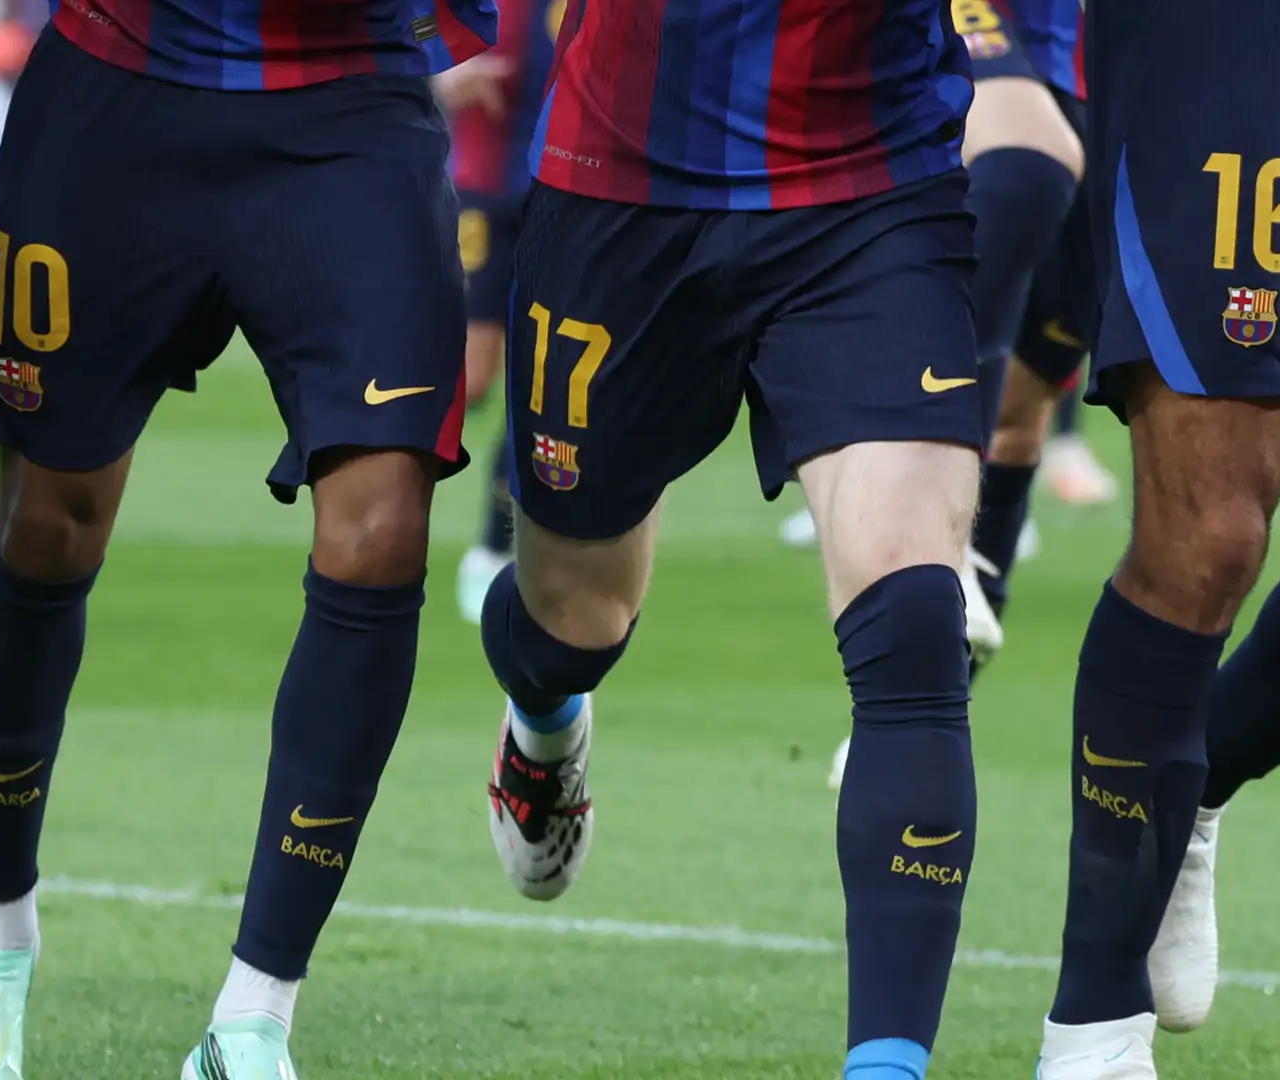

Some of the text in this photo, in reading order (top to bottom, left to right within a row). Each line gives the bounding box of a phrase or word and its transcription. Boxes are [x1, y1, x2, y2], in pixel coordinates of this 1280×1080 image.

[529, 301, 612, 429] 17
[1081, 774, 1149, 824] BARÇA
[281, 835, 345, 870] BARÇA
[890, 855, 963, 885] BARÇA
